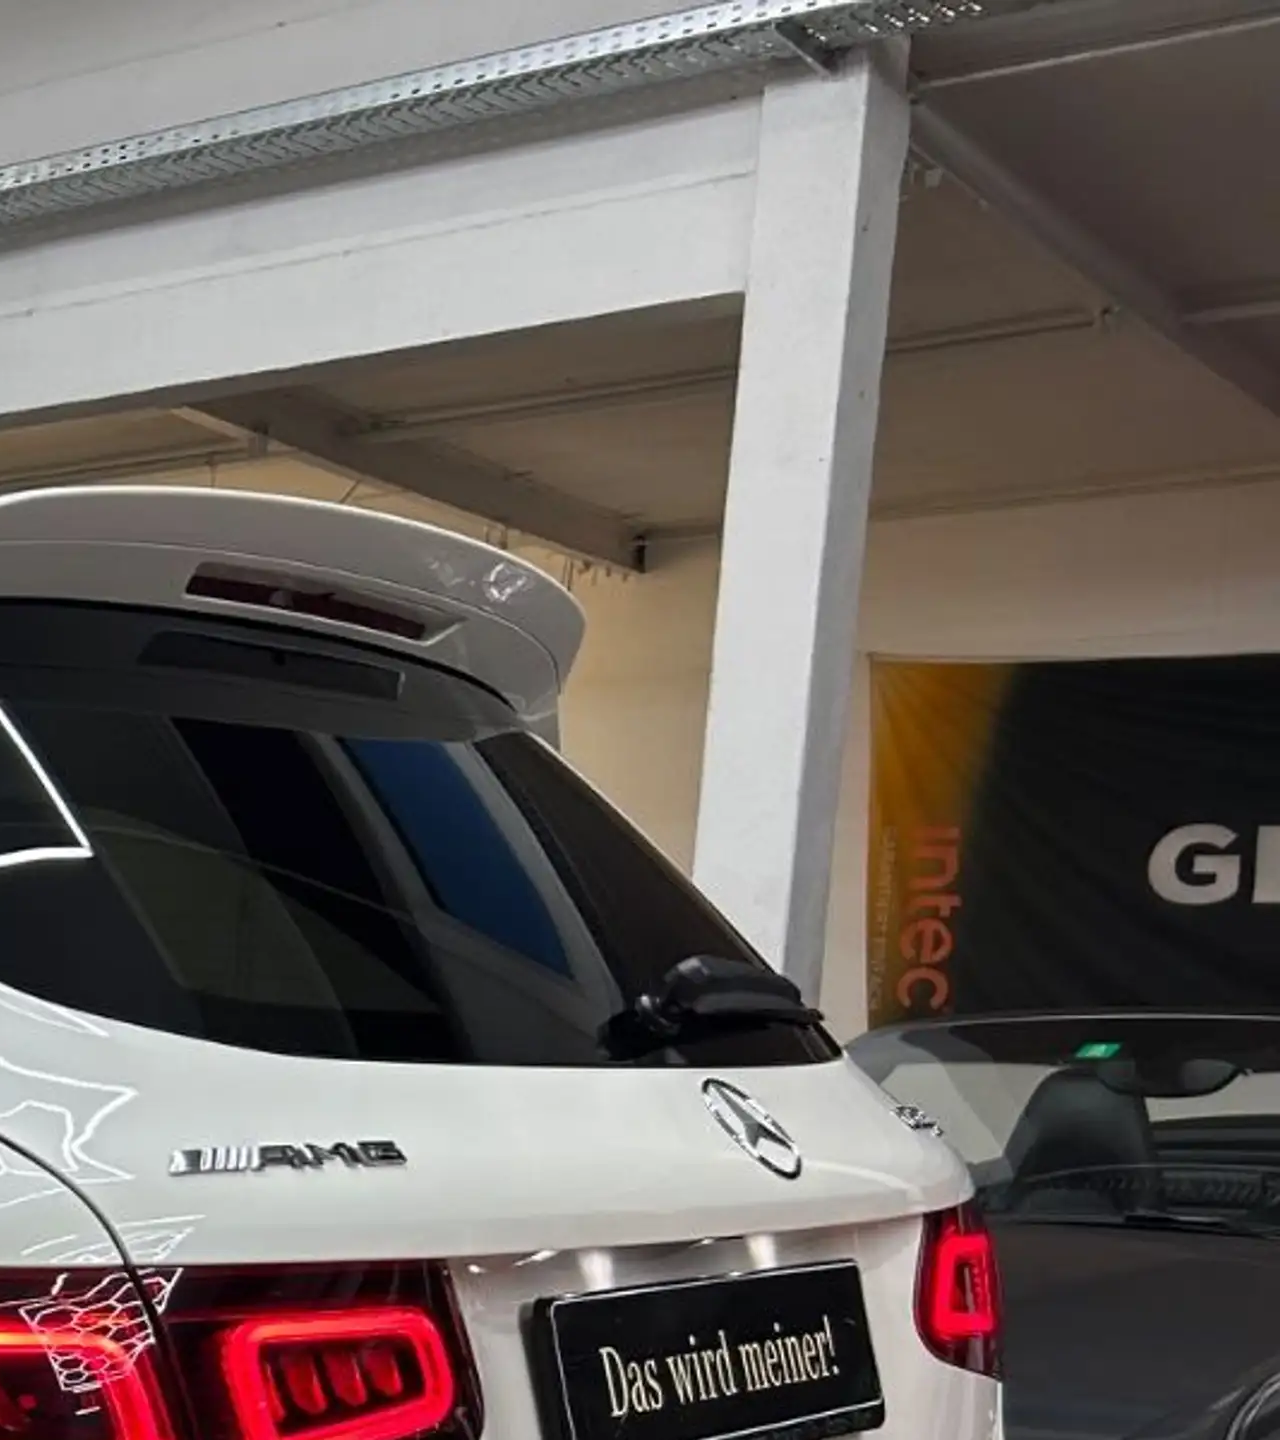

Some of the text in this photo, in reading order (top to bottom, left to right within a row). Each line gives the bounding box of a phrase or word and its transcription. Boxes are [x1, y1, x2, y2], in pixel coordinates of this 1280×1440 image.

[253, 1141, 407, 1172] AMG
[600, 1315, 840, 1418] Das wird meiner!
